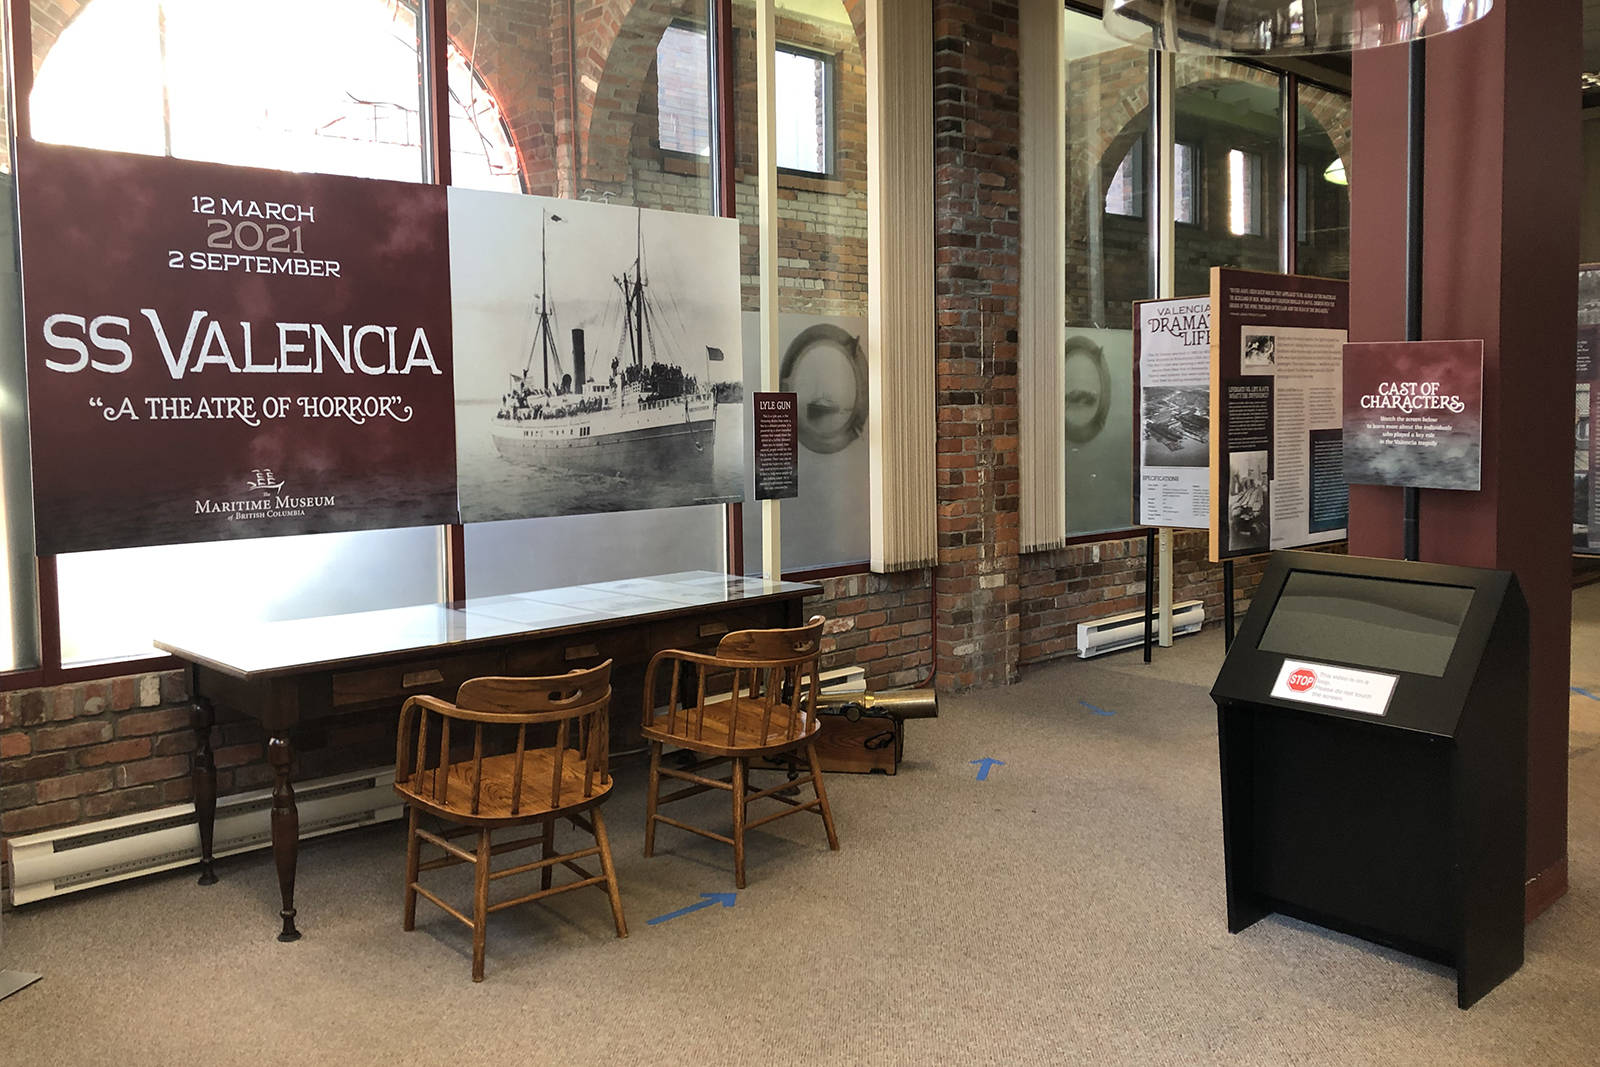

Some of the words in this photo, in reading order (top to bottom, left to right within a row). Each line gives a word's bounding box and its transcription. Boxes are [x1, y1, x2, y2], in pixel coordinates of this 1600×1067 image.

[192, 195, 216, 215] 12
[221, 198, 315, 223] MARCH
[207, 218, 305, 254] 2021
[168, 250, 185, 269] 2
[189, 252, 341, 278] SEPTEMBER
[1147, 313, 1211, 337] DRAMA
[43, 312, 134, 374] SS
[140, 308, 443, 380] VALENCIA
[1378, 381, 1418, 396] CAST
[1420, 381, 1441, 396] OF
[144, 396, 262, 427] THEATRE
[262, 396, 292, 420] OF
[759, 400, 776, 410] LYLE
[776, 400, 791, 410] GUN
[1360, 394, 1466, 414] CHARACTERS
[195, 499, 272, 515] MARITIME
[275, 495, 336, 510] MUSEUM
[235, 511, 265, 520] BRITISH
[266, 509, 305, 519] COLUMBIA
[1290, 674, 1314, 686] STOP
